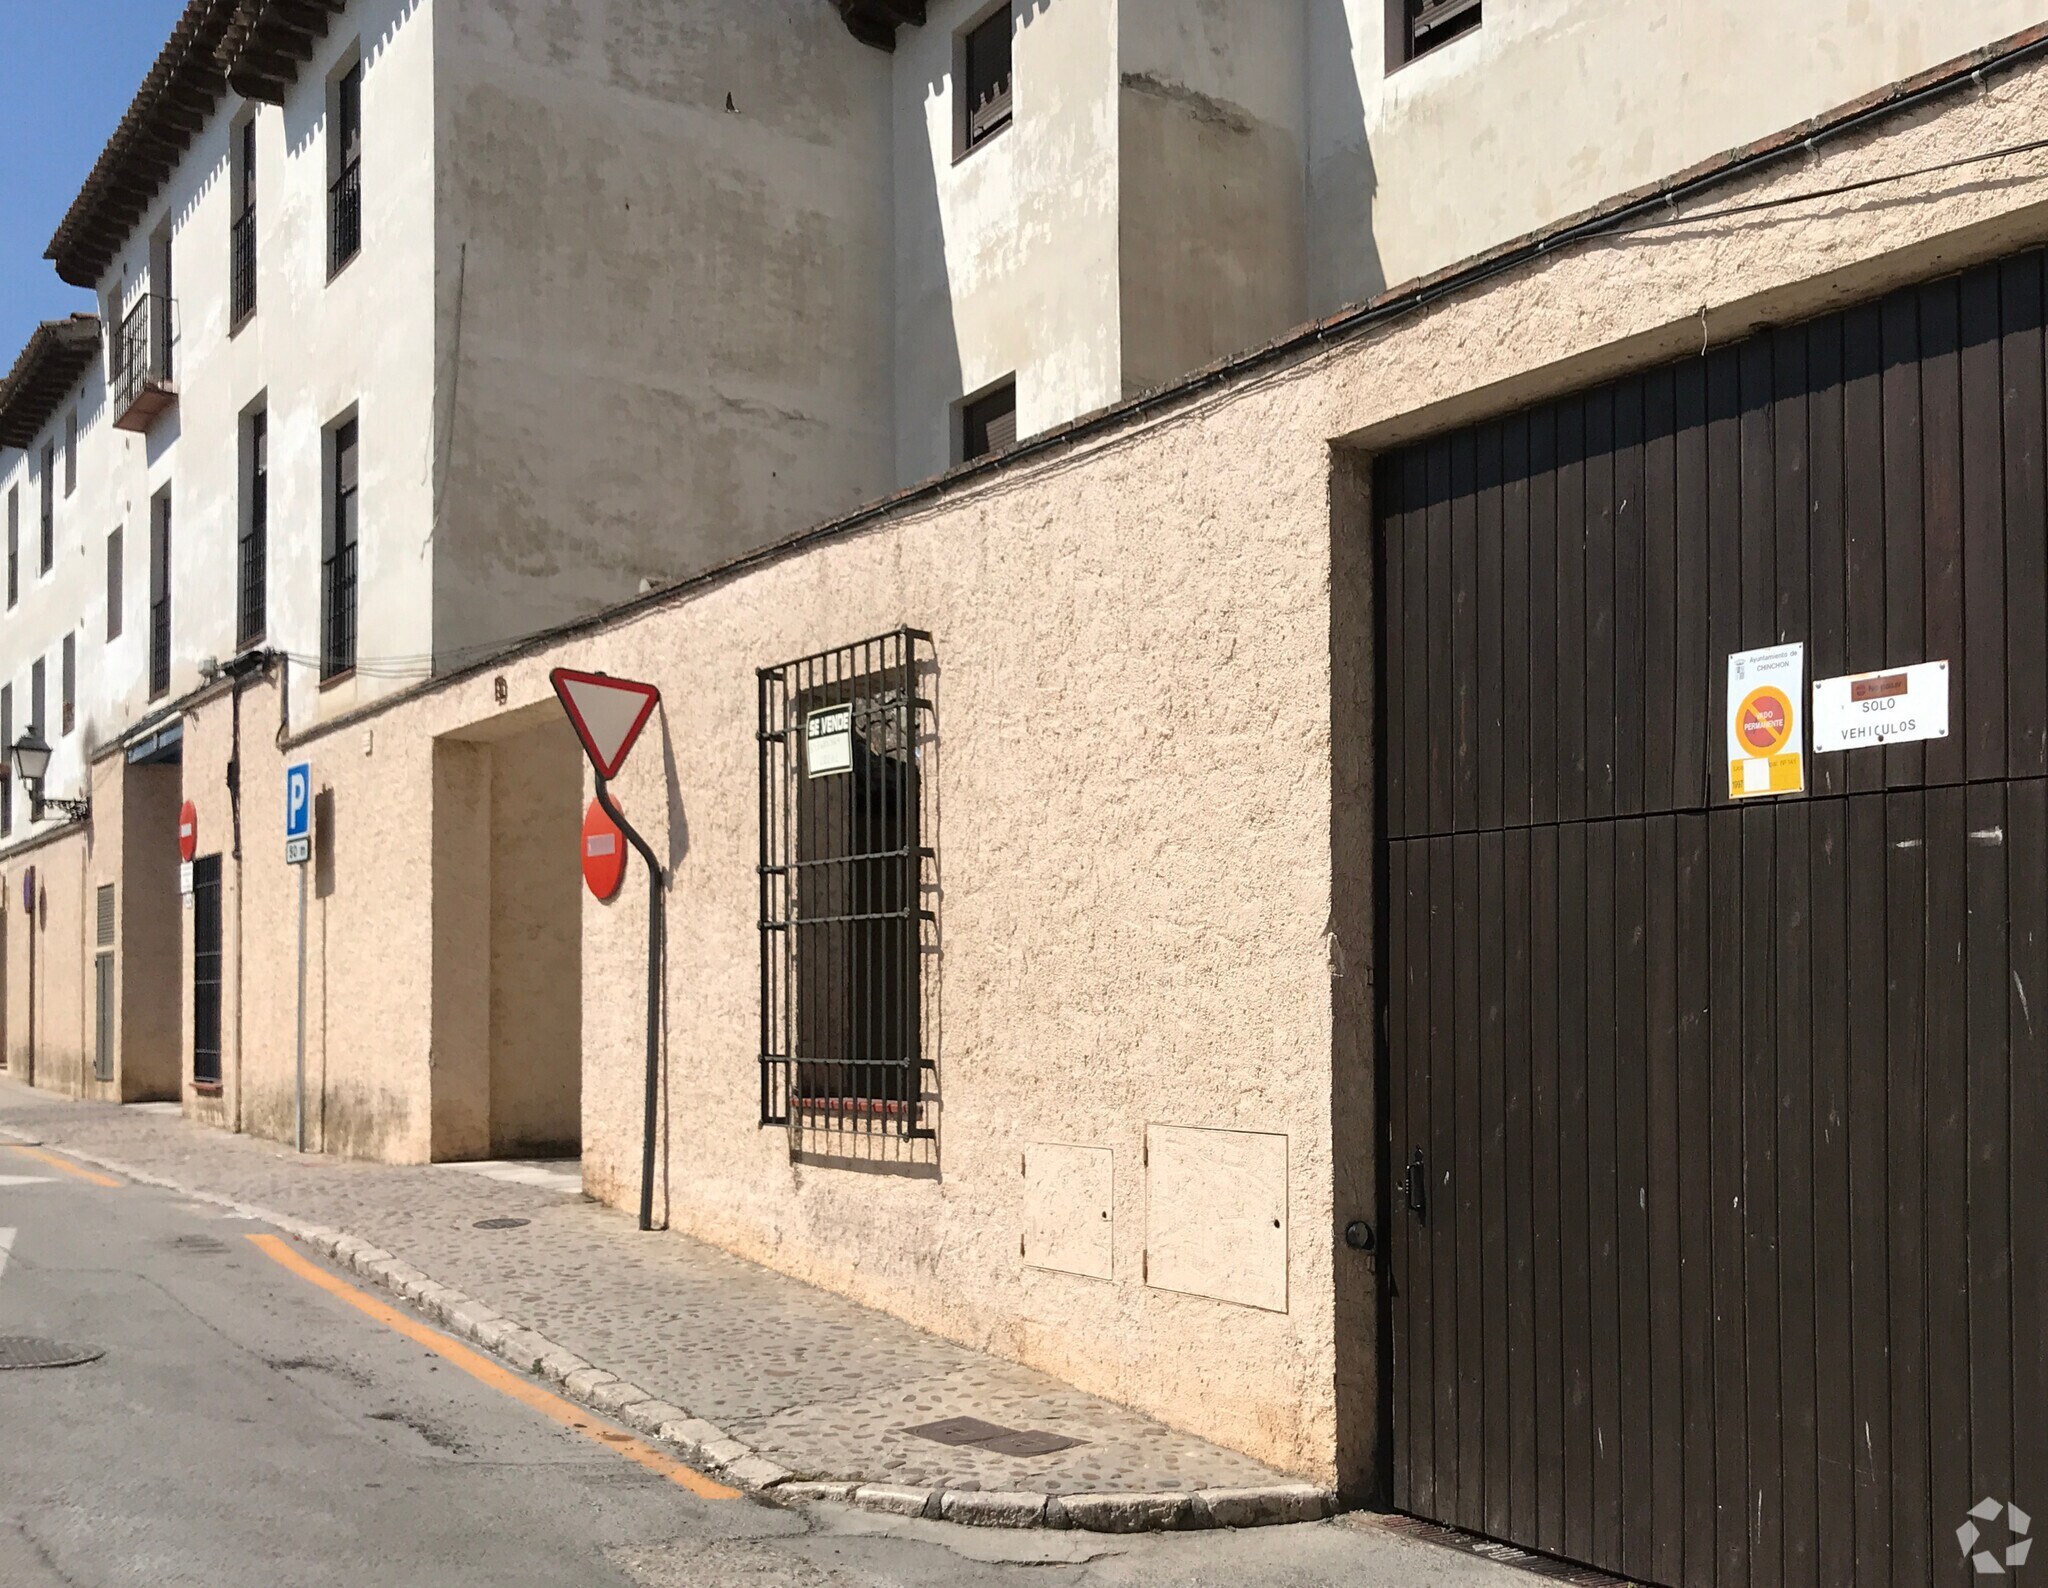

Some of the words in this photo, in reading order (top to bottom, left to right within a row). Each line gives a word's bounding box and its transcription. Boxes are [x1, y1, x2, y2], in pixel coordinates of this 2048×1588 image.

[1750, 652, 1788, 663] Ayuntamiento
[1862, 698, 1895, 713] SOLO
[1756, 710, 1773, 719] VADO
[809, 719, 820, 738] SE
[821, 712, 849, 735] VENDE
[1744, 719, 1783, 731] PERMANENTE
[1841, 719, 1916, 740] VEHICULOS
[291, 773, 305, 829] P
